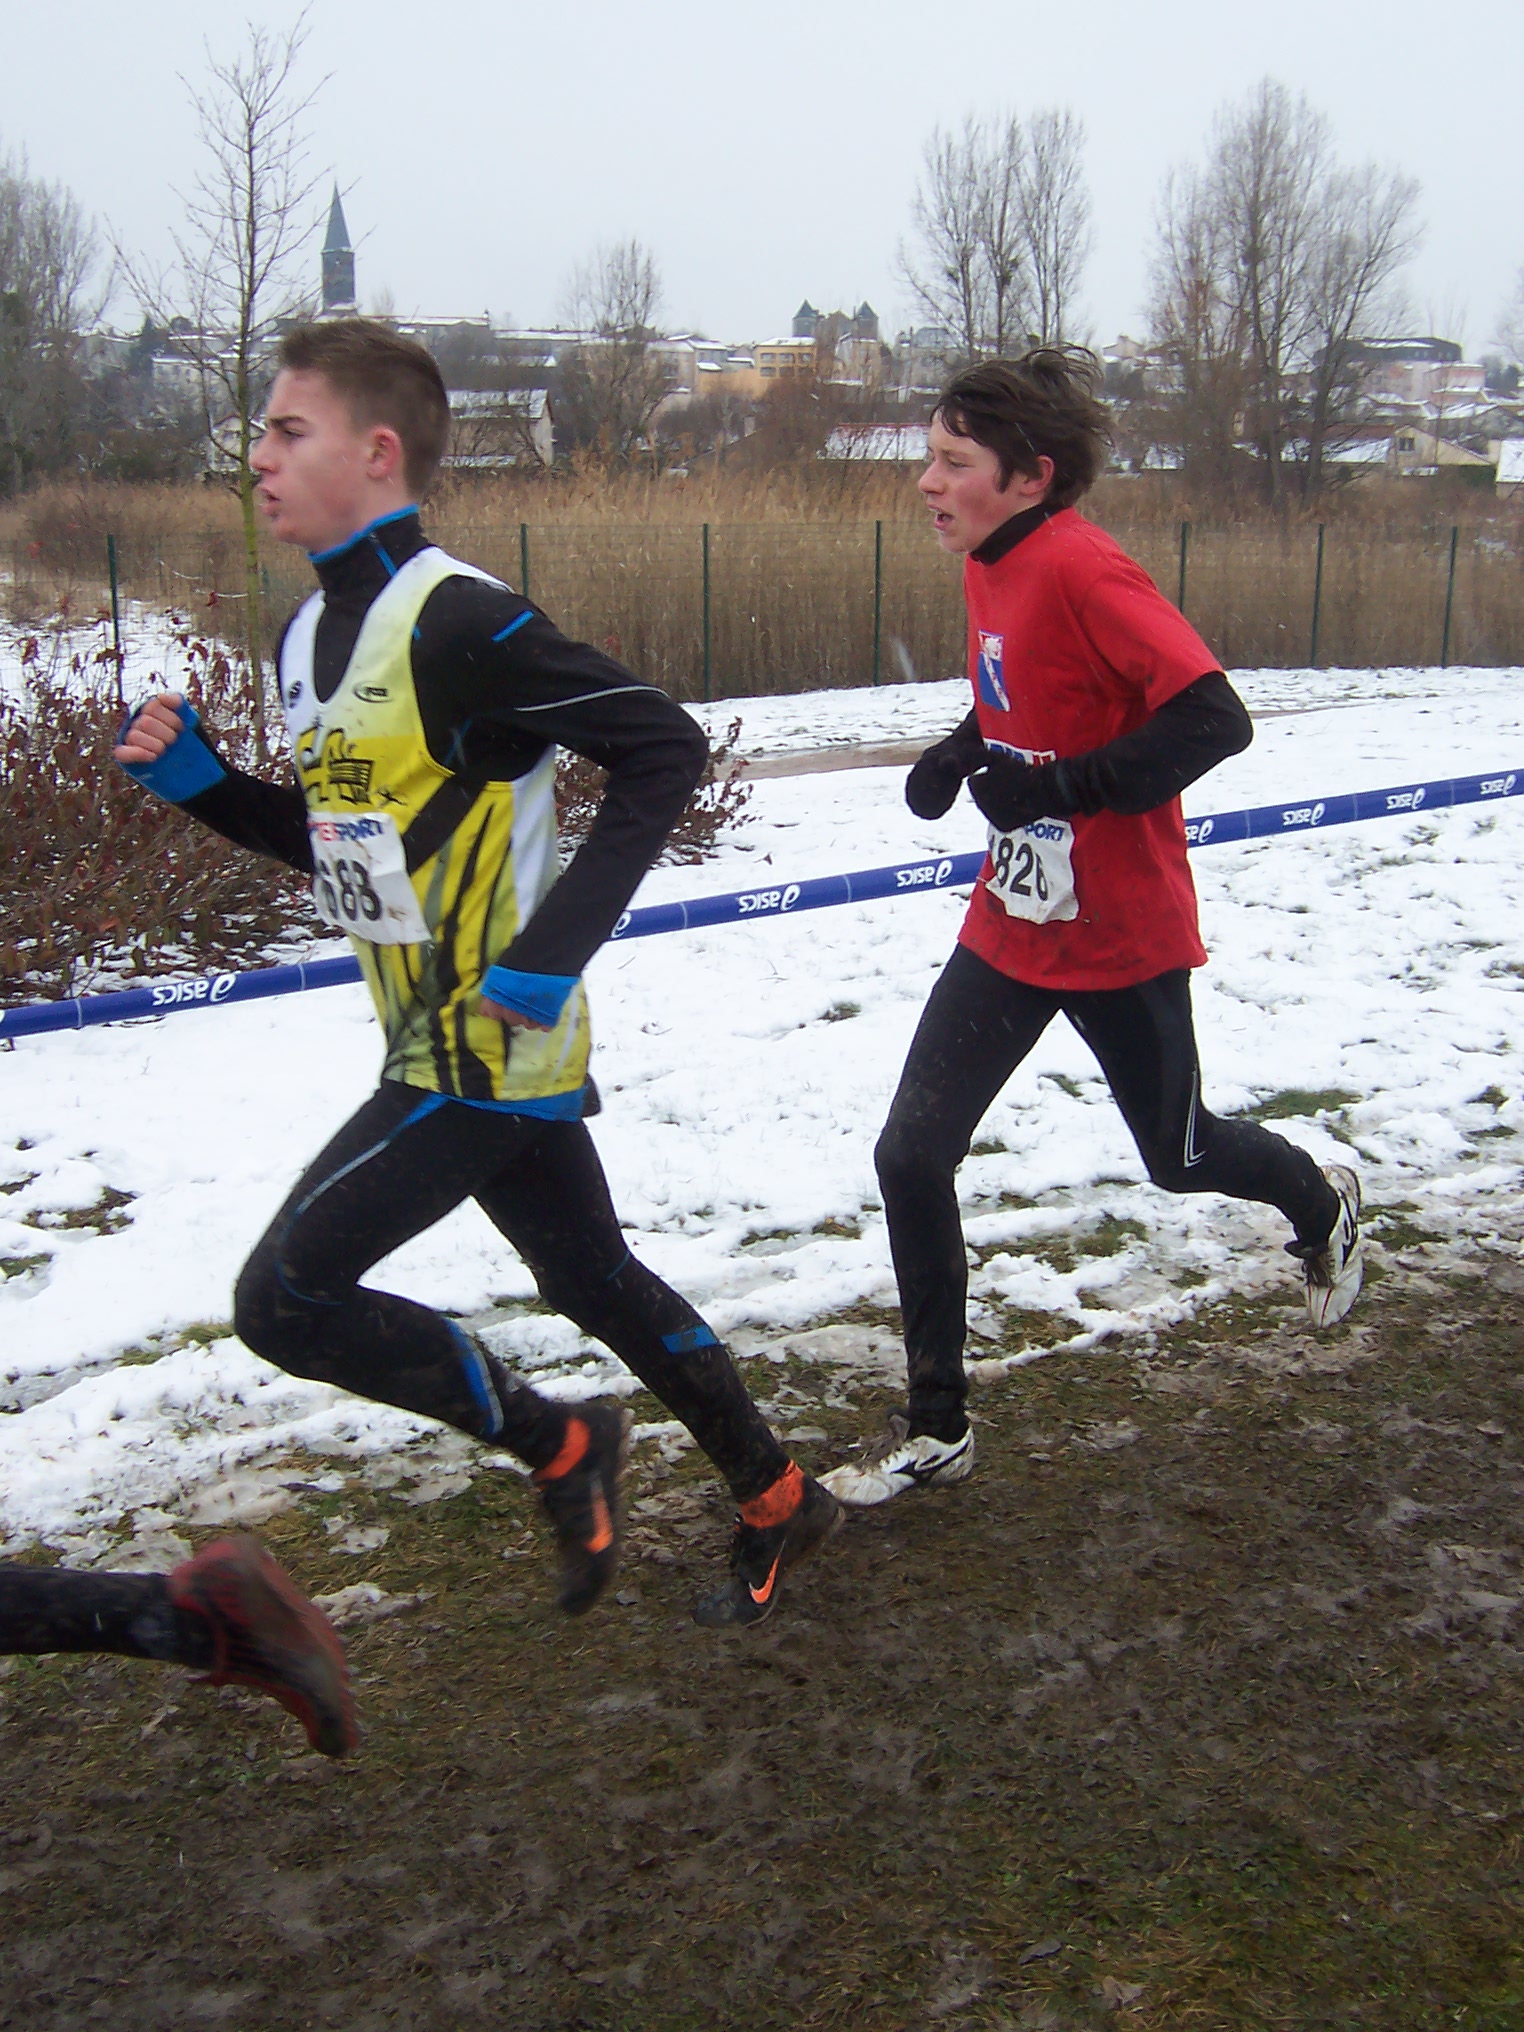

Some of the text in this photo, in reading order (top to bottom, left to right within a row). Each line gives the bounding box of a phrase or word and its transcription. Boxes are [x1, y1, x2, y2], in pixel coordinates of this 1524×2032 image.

[1386, 793, 1414, 811] asics
[1282, 808, 1312, 826] asics
[897, 867, 936, 888] asics
[738, 890, 781, 914] asics
[152, 981, 209, 1006] asics
